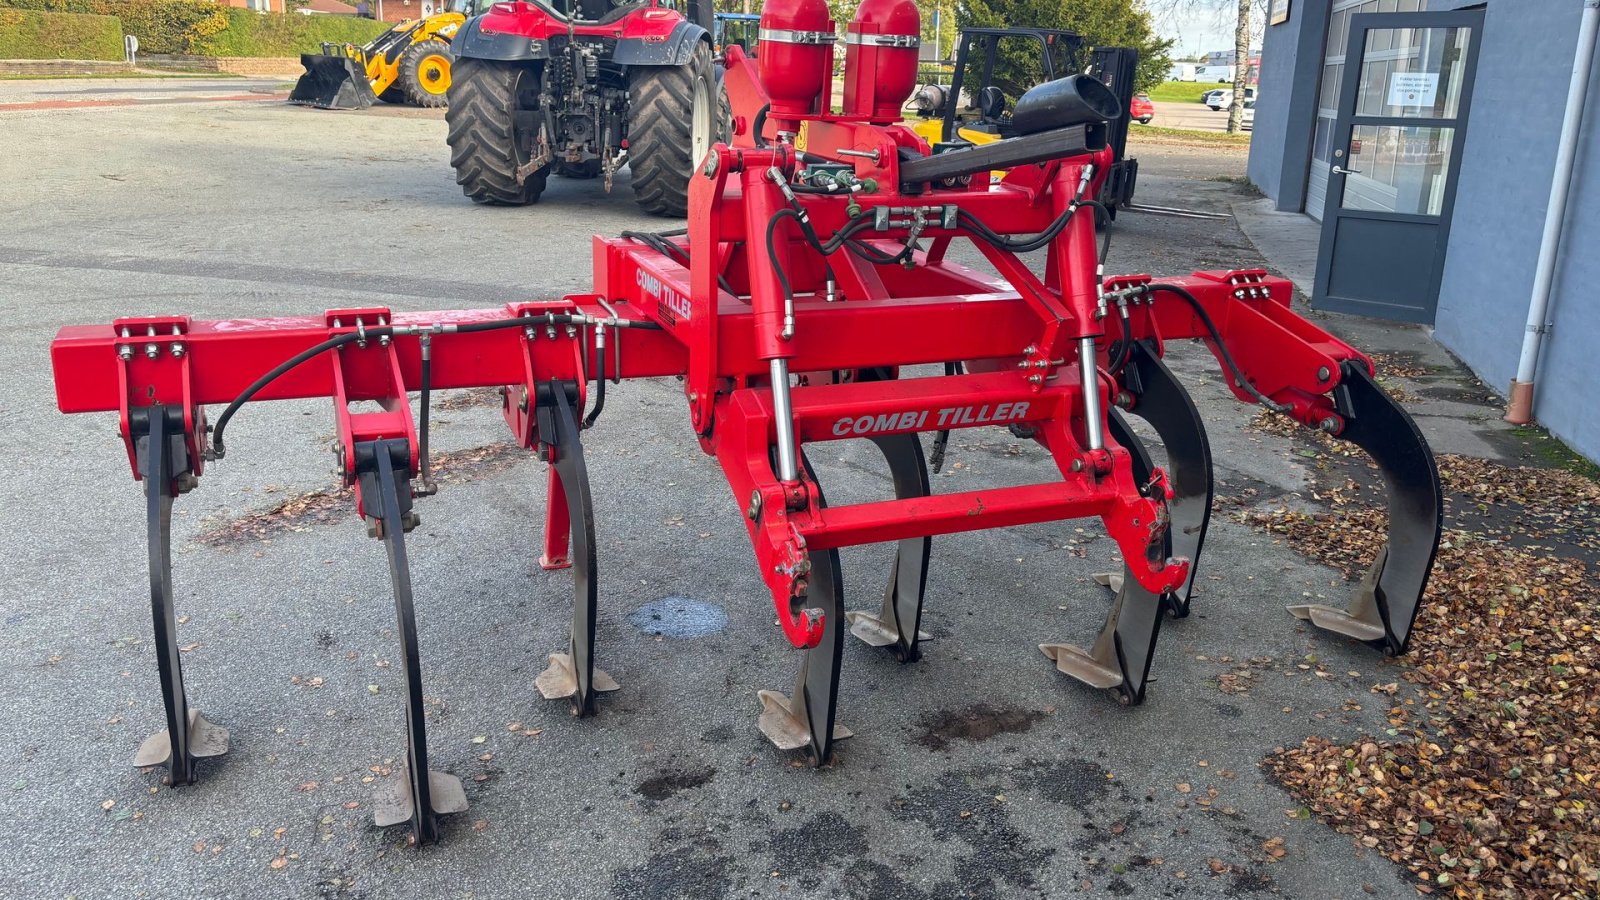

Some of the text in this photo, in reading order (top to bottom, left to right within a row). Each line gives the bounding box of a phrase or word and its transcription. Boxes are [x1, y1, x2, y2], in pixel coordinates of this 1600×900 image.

[636, 267, 661, 300] COMBI
[832, 402, 1030, 436] COMBI TILLER
